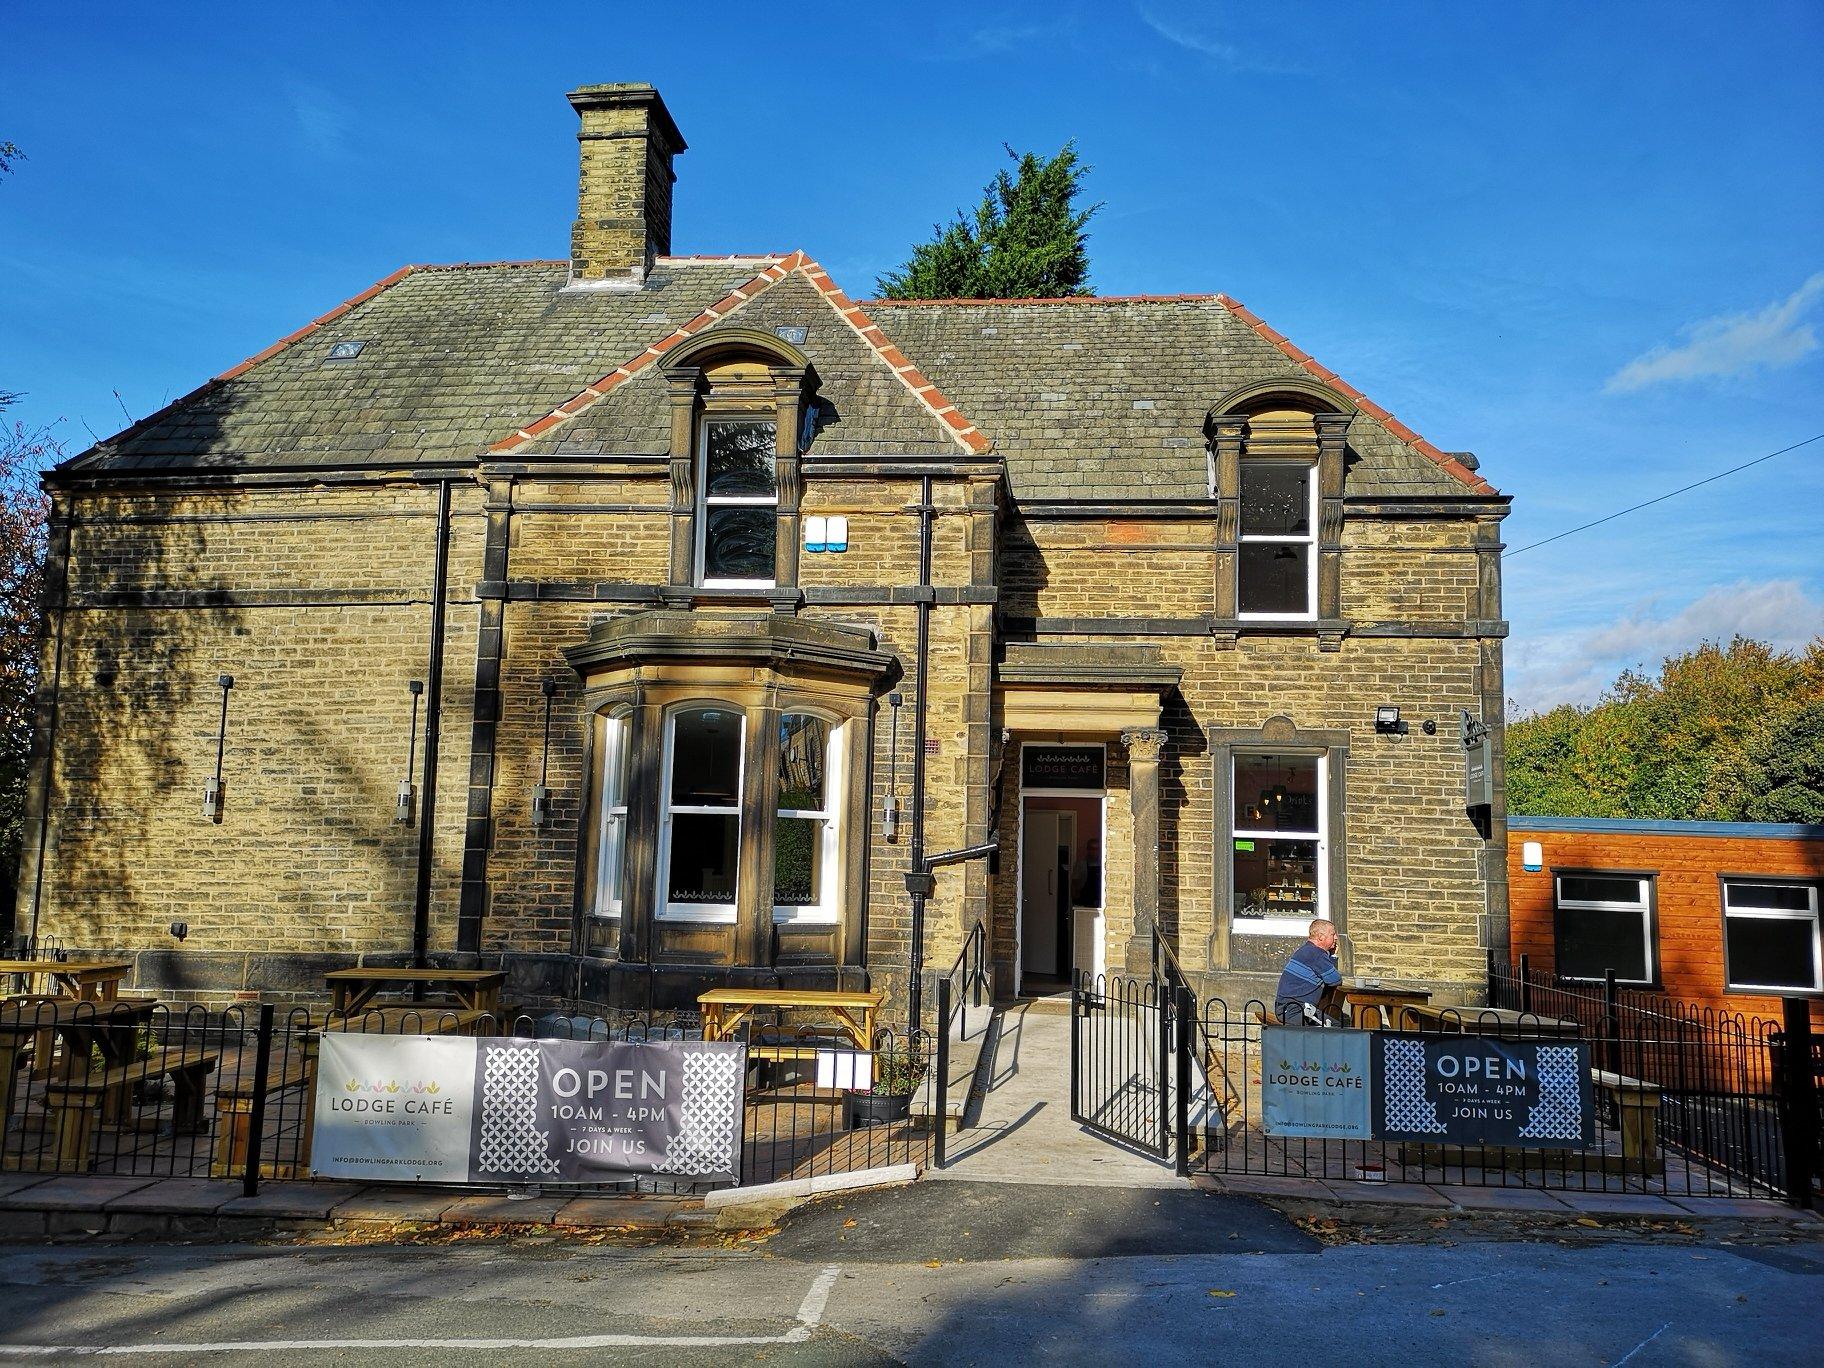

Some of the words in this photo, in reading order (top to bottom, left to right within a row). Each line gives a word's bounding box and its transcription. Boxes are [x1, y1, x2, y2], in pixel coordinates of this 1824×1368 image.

[1029, 763, 1065, 773] LODGE
[1437, 1055, 1526, 1080] OPEN
[552, 1067, 666, 1099] OPEN
[1269, 1074, 1319, 1087] LODGE
[1325, 1076, 1362, 1088] CAFÉ
[1438, 1082, 1478, 1094] 10AM
[1496, 1084, 1526, 1096] 4PM
[331, 1097, 395, 1113] LODGE
[404, 1098, 454, 1115] CAFÉ
[551, 1105, 603, 1120] 10AM
[626, 1107, 665, 1121] 4PM
[1452, 1107, 1488, 1119] JOIN
[1494, 1108, 1513, 1120] US
[566, 1138, 613, 1154] JOIN
[622, 1140, 645, 1155] US
[332, 1156, 443, 1167] INFO@BOWLINGPARKLODGE.ORG
